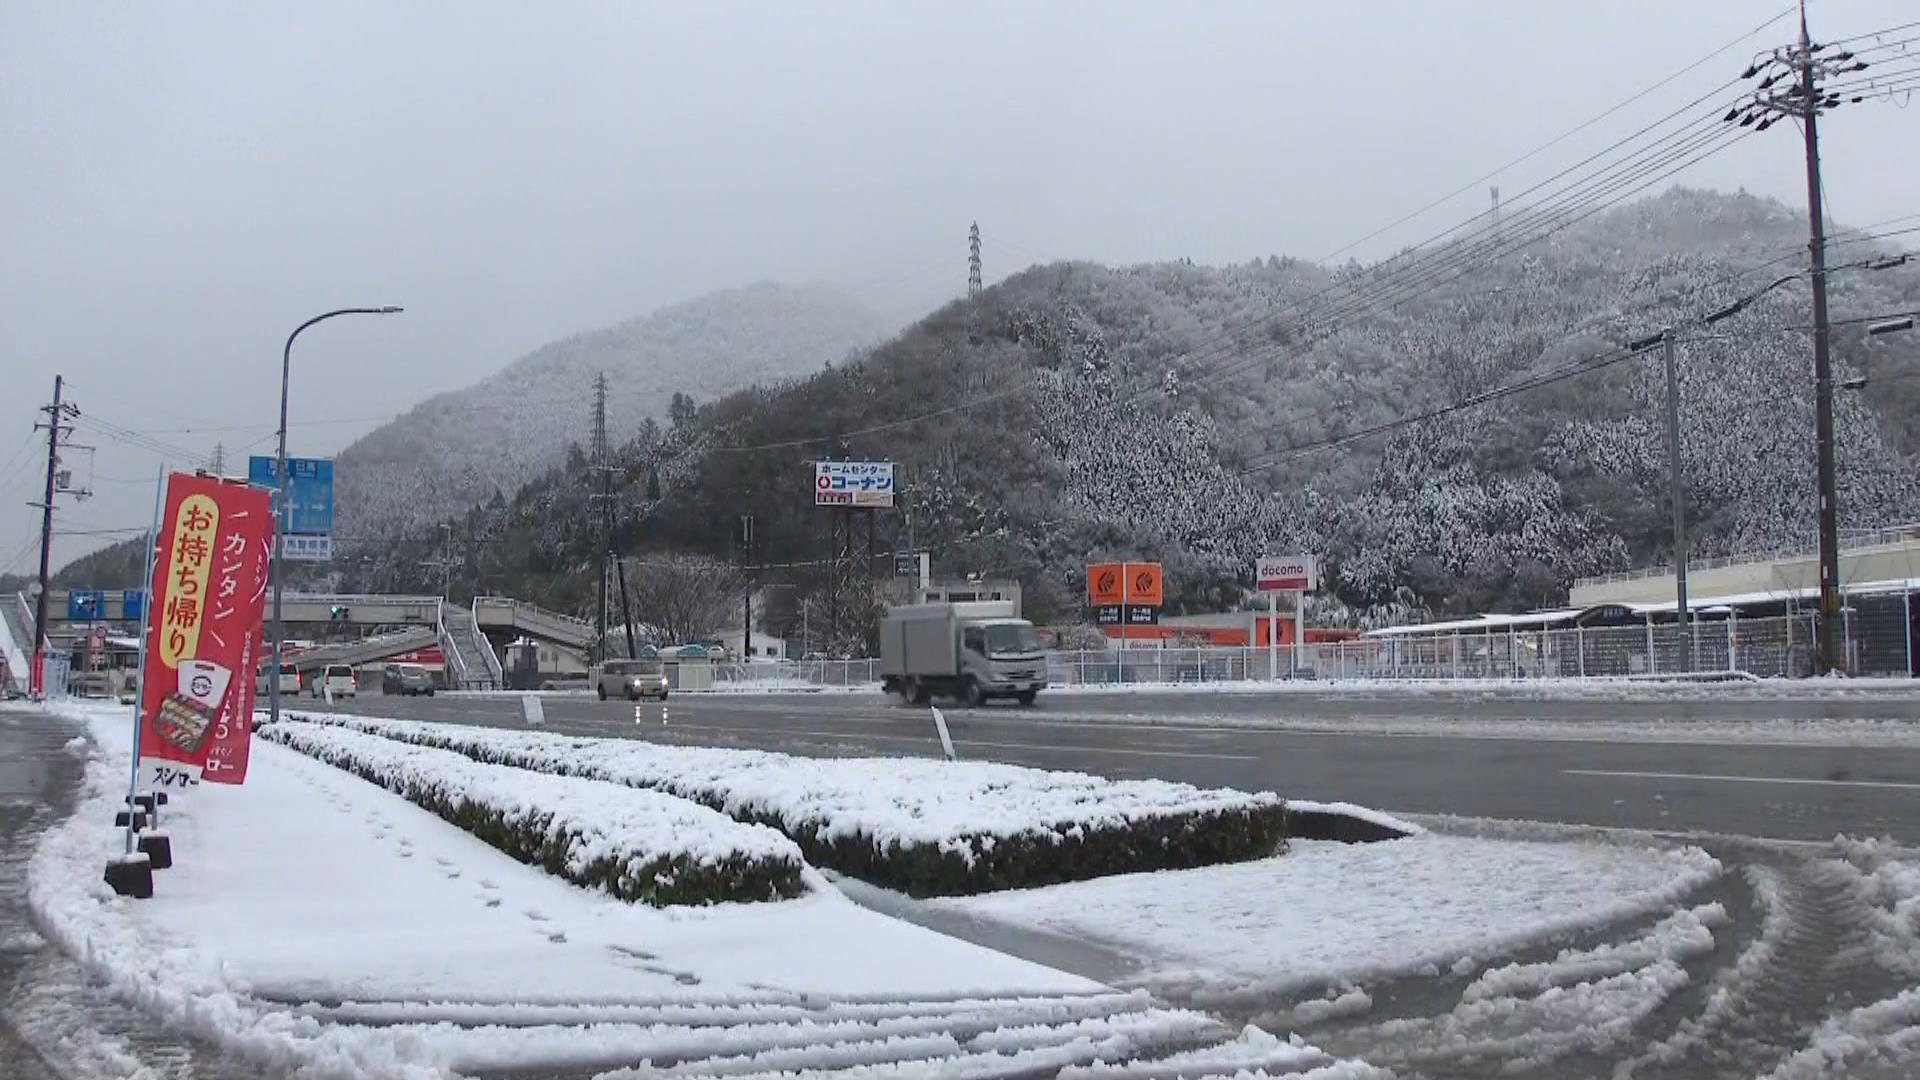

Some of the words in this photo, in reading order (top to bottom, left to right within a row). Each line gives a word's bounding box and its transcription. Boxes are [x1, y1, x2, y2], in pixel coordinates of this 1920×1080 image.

[822, 465, 887, 474] ホームセンター
[831, 476, 891, 490] コーナン
[215, 532, 247, 619] カンタン
[1261, 565, 1304, 576] docomo
[167, 504, 213, 657] お持ち帰り
[152, 766, 199, 788] スシロー
